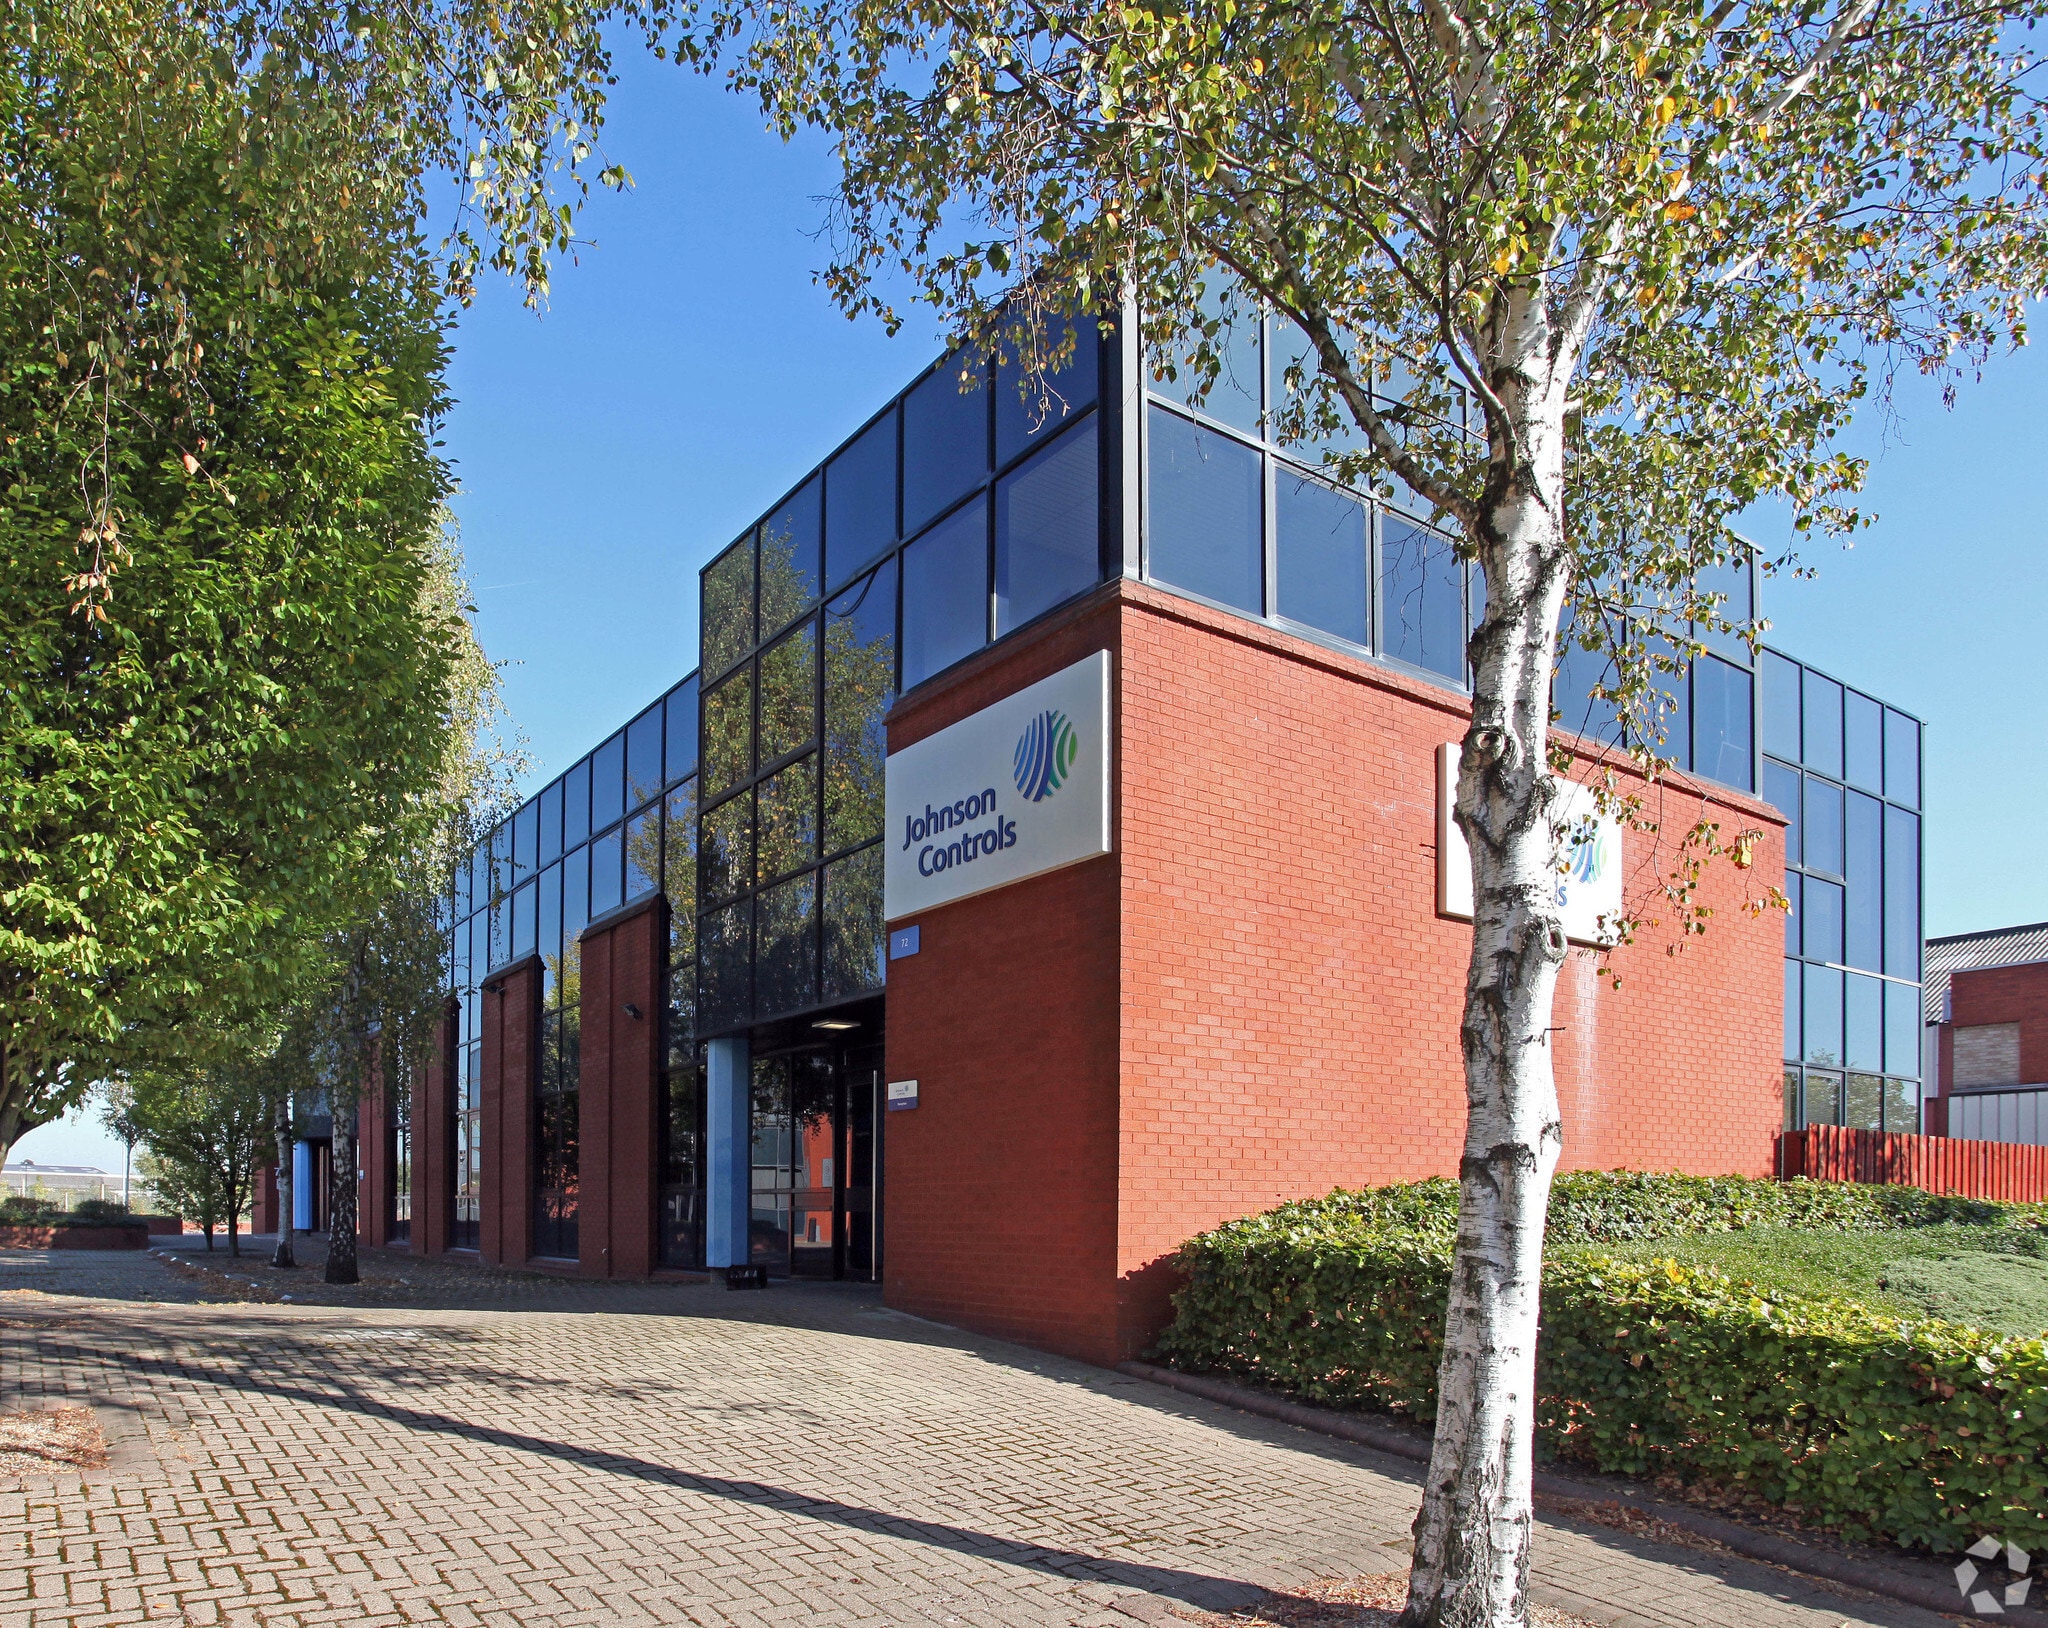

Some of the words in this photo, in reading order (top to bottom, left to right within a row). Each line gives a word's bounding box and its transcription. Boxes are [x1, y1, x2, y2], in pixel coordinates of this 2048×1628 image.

[903, 788, 996, 851] Johnson
[918, 815, 1017, 877] Controls
[901, 938, 909, 948] 72
